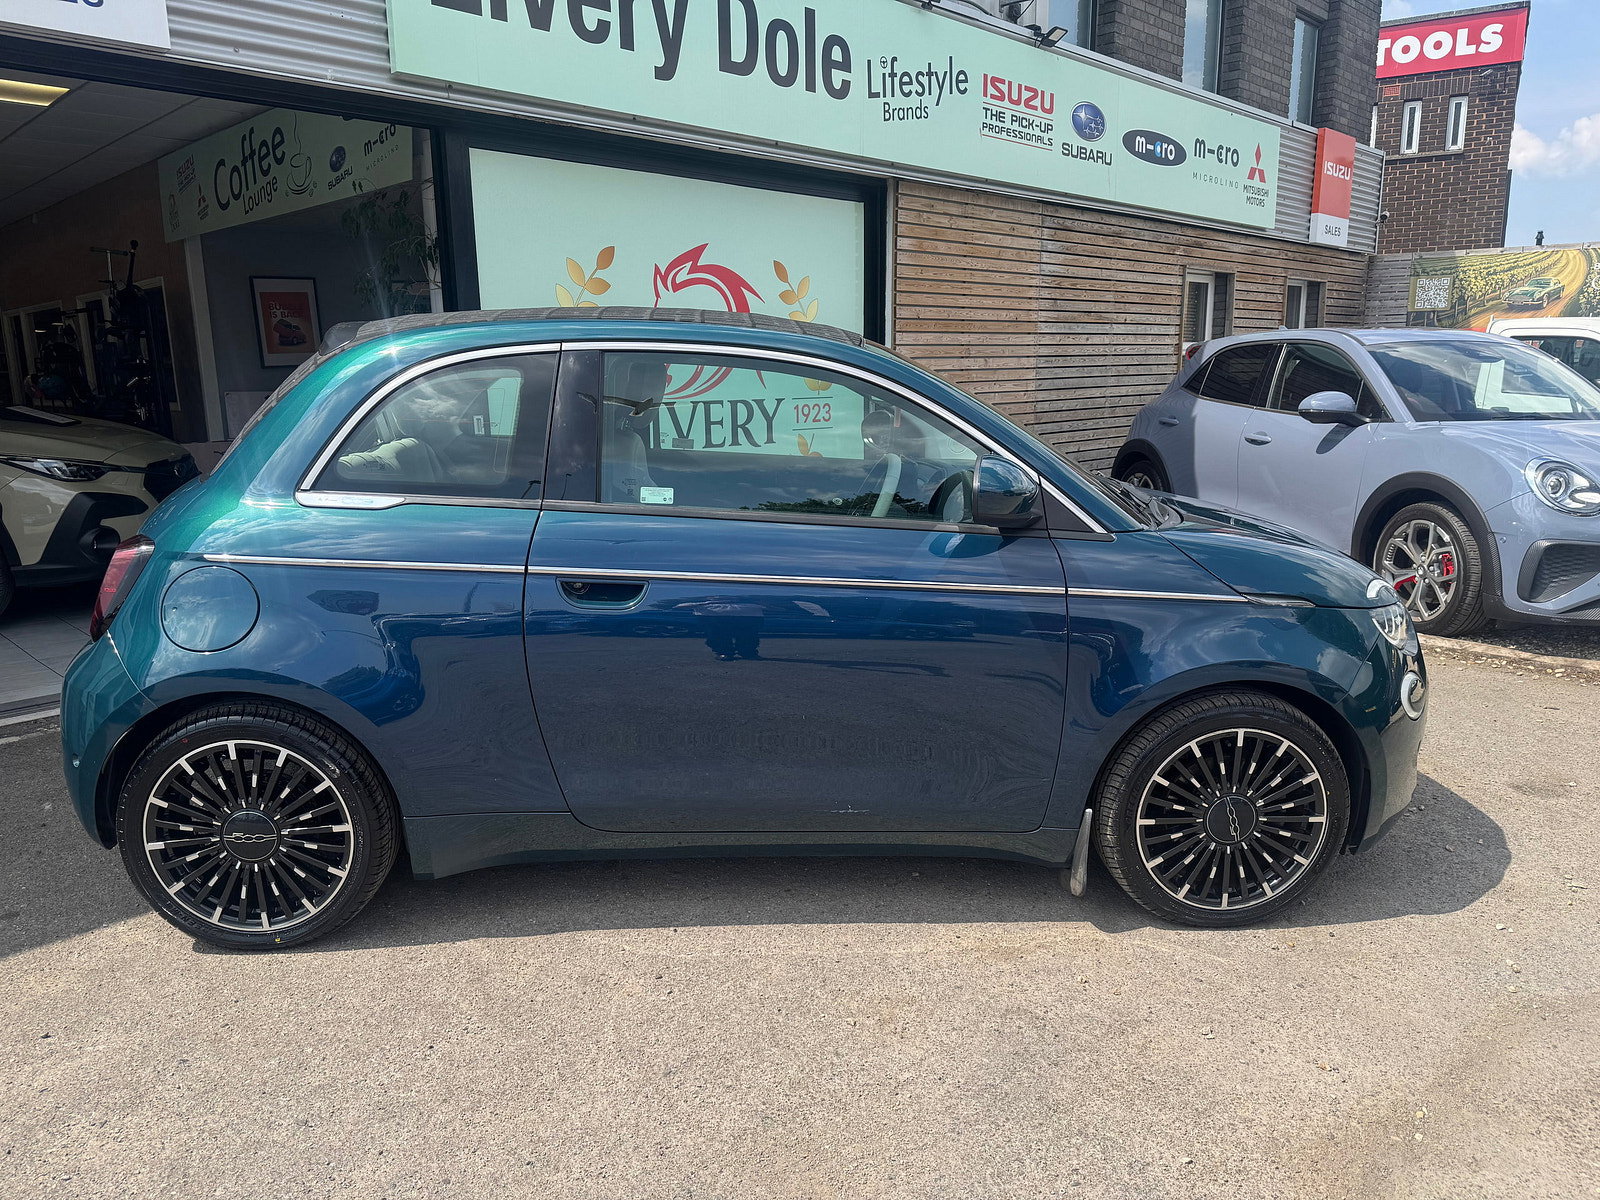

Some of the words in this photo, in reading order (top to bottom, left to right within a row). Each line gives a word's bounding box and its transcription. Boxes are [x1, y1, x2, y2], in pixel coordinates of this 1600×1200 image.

[718, 0, 852, 100] Dole
[1376, 23, 1504, 67] TOOLS
[866, 55, 969, 107] Lifestyle
[982, 73, 1055, 115] ISUZU
[882, 99, 929, 122] Brands
[982, 106, 1006, 123] THE
[1010, 113, 1054, 135] PICK-UP
[982, 121, 1054, 147] PROFESSIONALS
[1061, 142, 1113, 167] SUBARU
[213, 126, 286, 212] Coffee
[327, 166, 354, 192] SUBARU
[1192, 171, 1240, 190] MICROLINO
[1323, 160, 1351, 181] ISUZU
[243, 175, 278, 216] Lounge
[1242, 183, 1270, 199] MITSUBISHI
[1245, 195, 1266, 208] MOTORS
[1324, 223, 1342, 237] SALES
[793, 403, 832, 425] 1923
